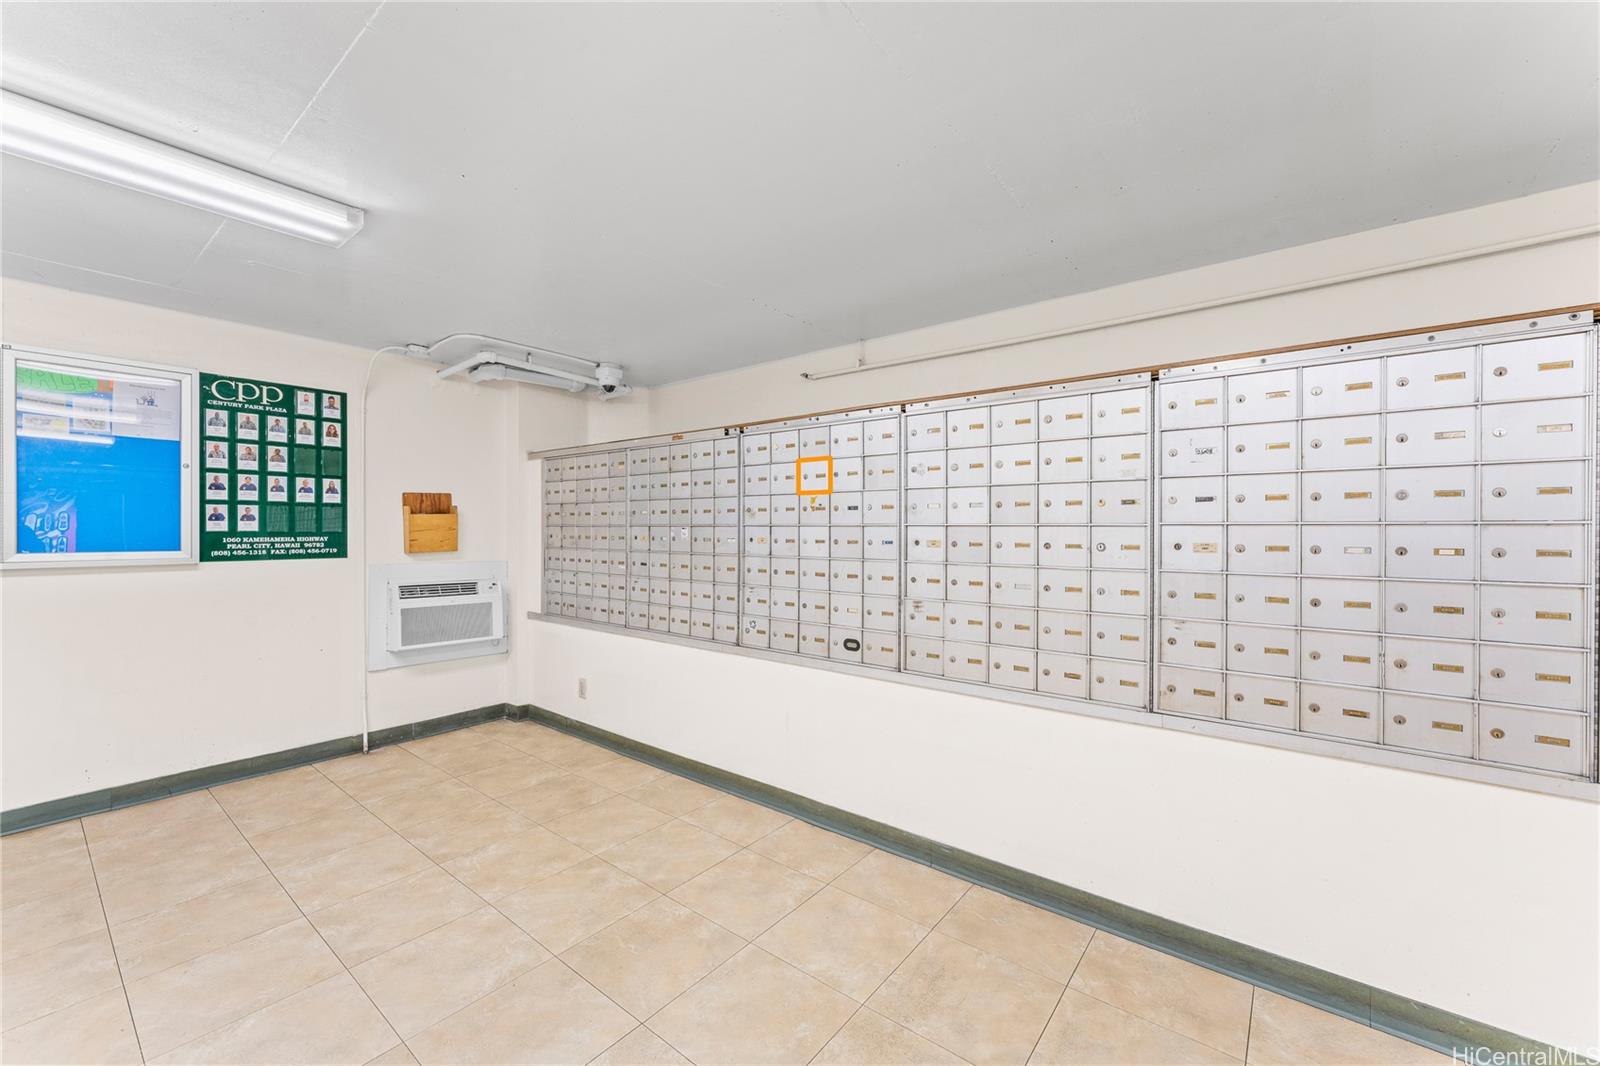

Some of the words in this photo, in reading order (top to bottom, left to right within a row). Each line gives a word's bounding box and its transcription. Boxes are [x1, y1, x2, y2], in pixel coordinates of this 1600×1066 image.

[211, 380, 283, 405] CPP
[208, 400, 242, 408] CENTURY
[244, 403, 264, 411] PARK
[266, 405, 287, 413] PLAZA
